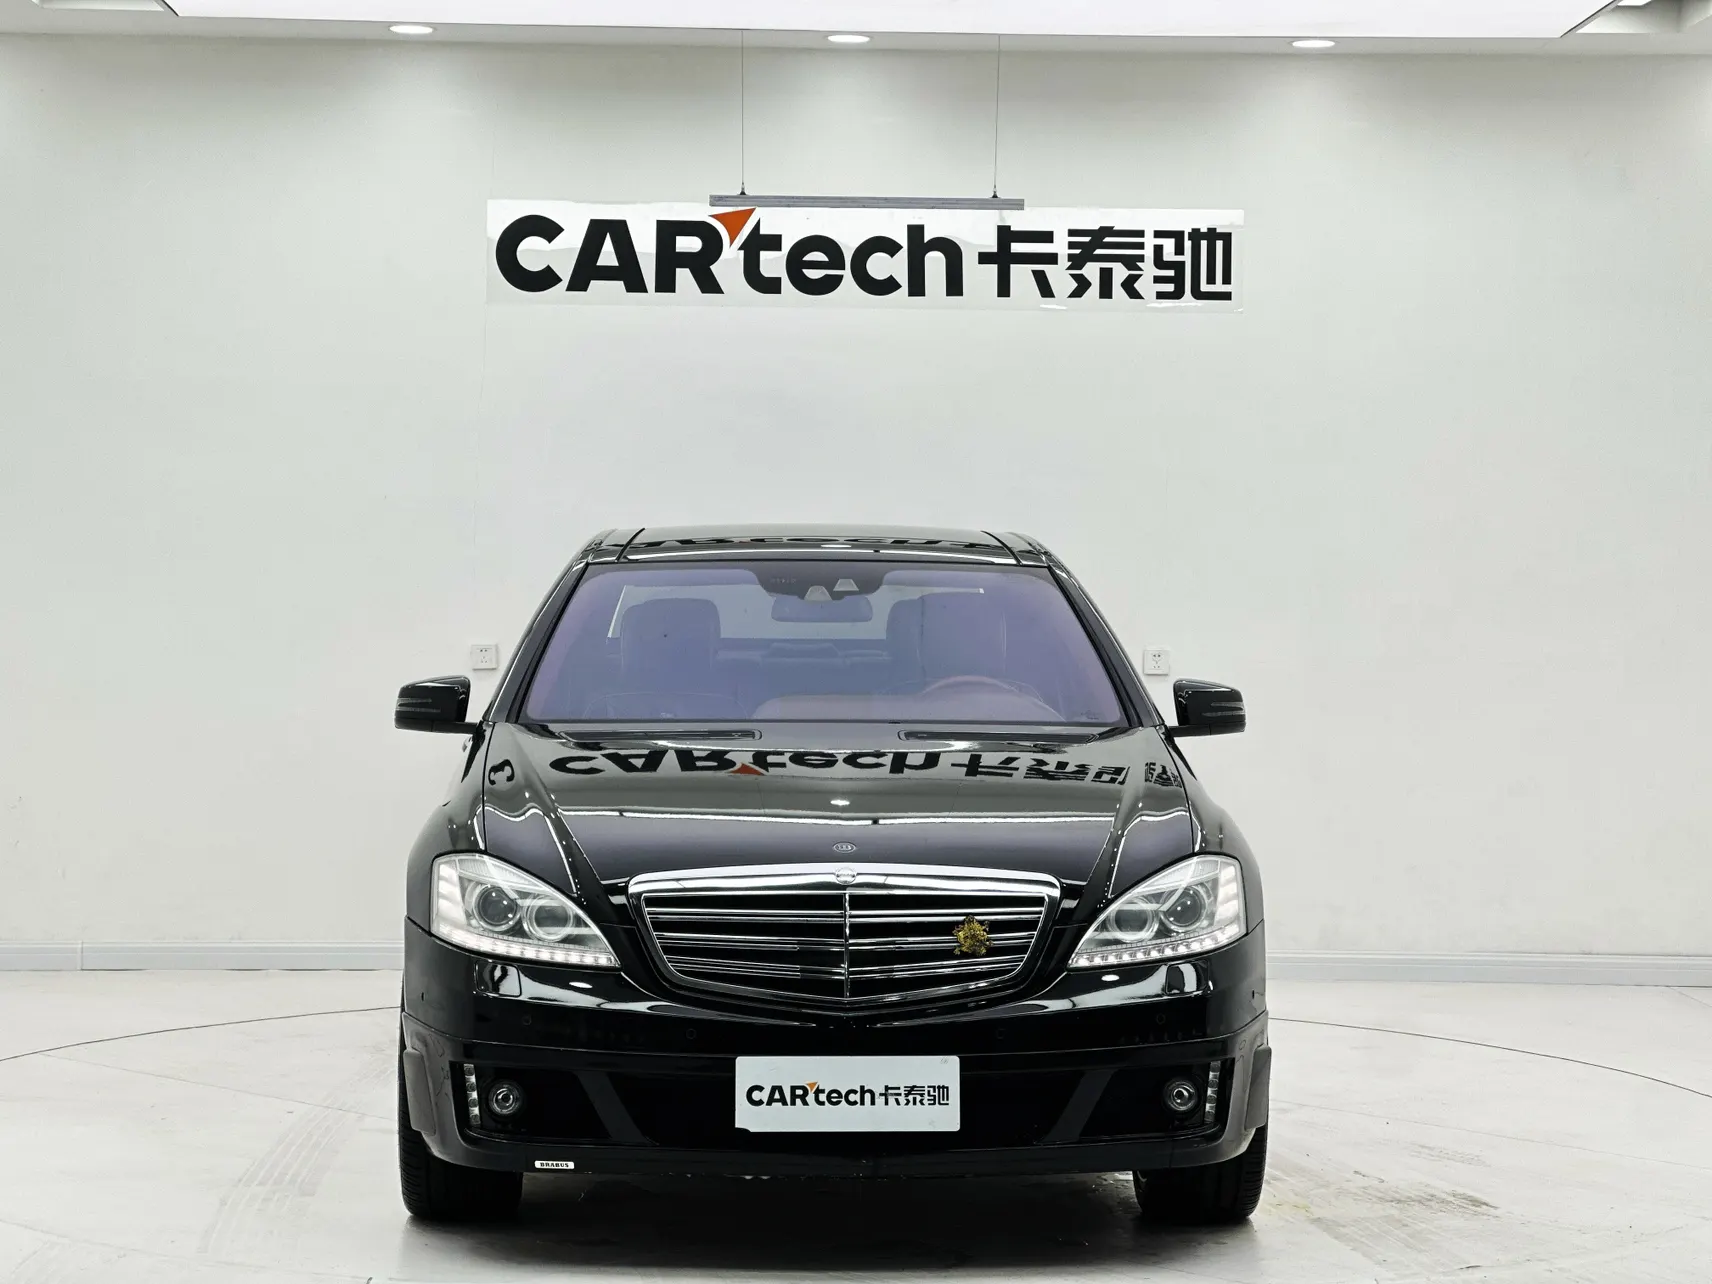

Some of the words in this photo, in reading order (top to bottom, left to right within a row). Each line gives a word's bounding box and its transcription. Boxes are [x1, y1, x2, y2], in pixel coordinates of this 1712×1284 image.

[496, 210, 963, 297] CARtech
[978, 225, 1232, 300] 卡泰驰
[746, 1082, 875, 1107] CARtech
[879, 1085, 950, 1106] 卡泰驰
